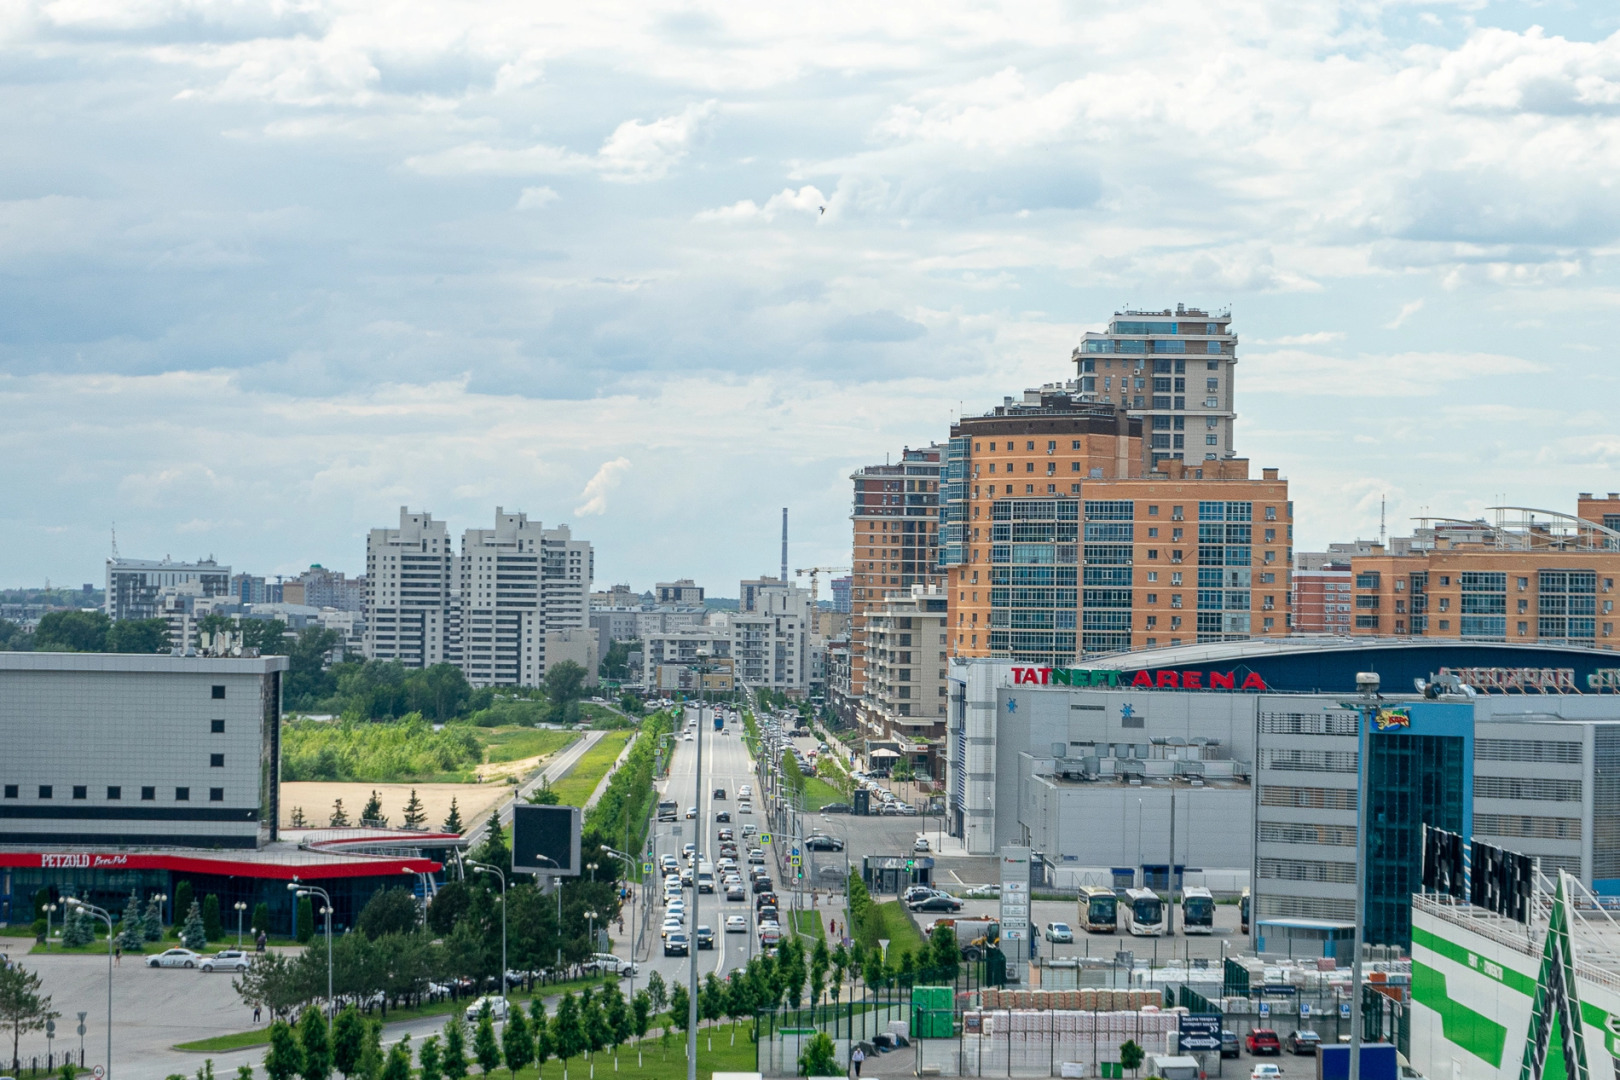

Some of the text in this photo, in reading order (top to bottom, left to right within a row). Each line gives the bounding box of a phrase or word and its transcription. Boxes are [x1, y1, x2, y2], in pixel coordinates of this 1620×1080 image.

[1011, 667, 1267, 690] TATNEFT ARENA
[41, 853, 90, 868] PETZOLD
